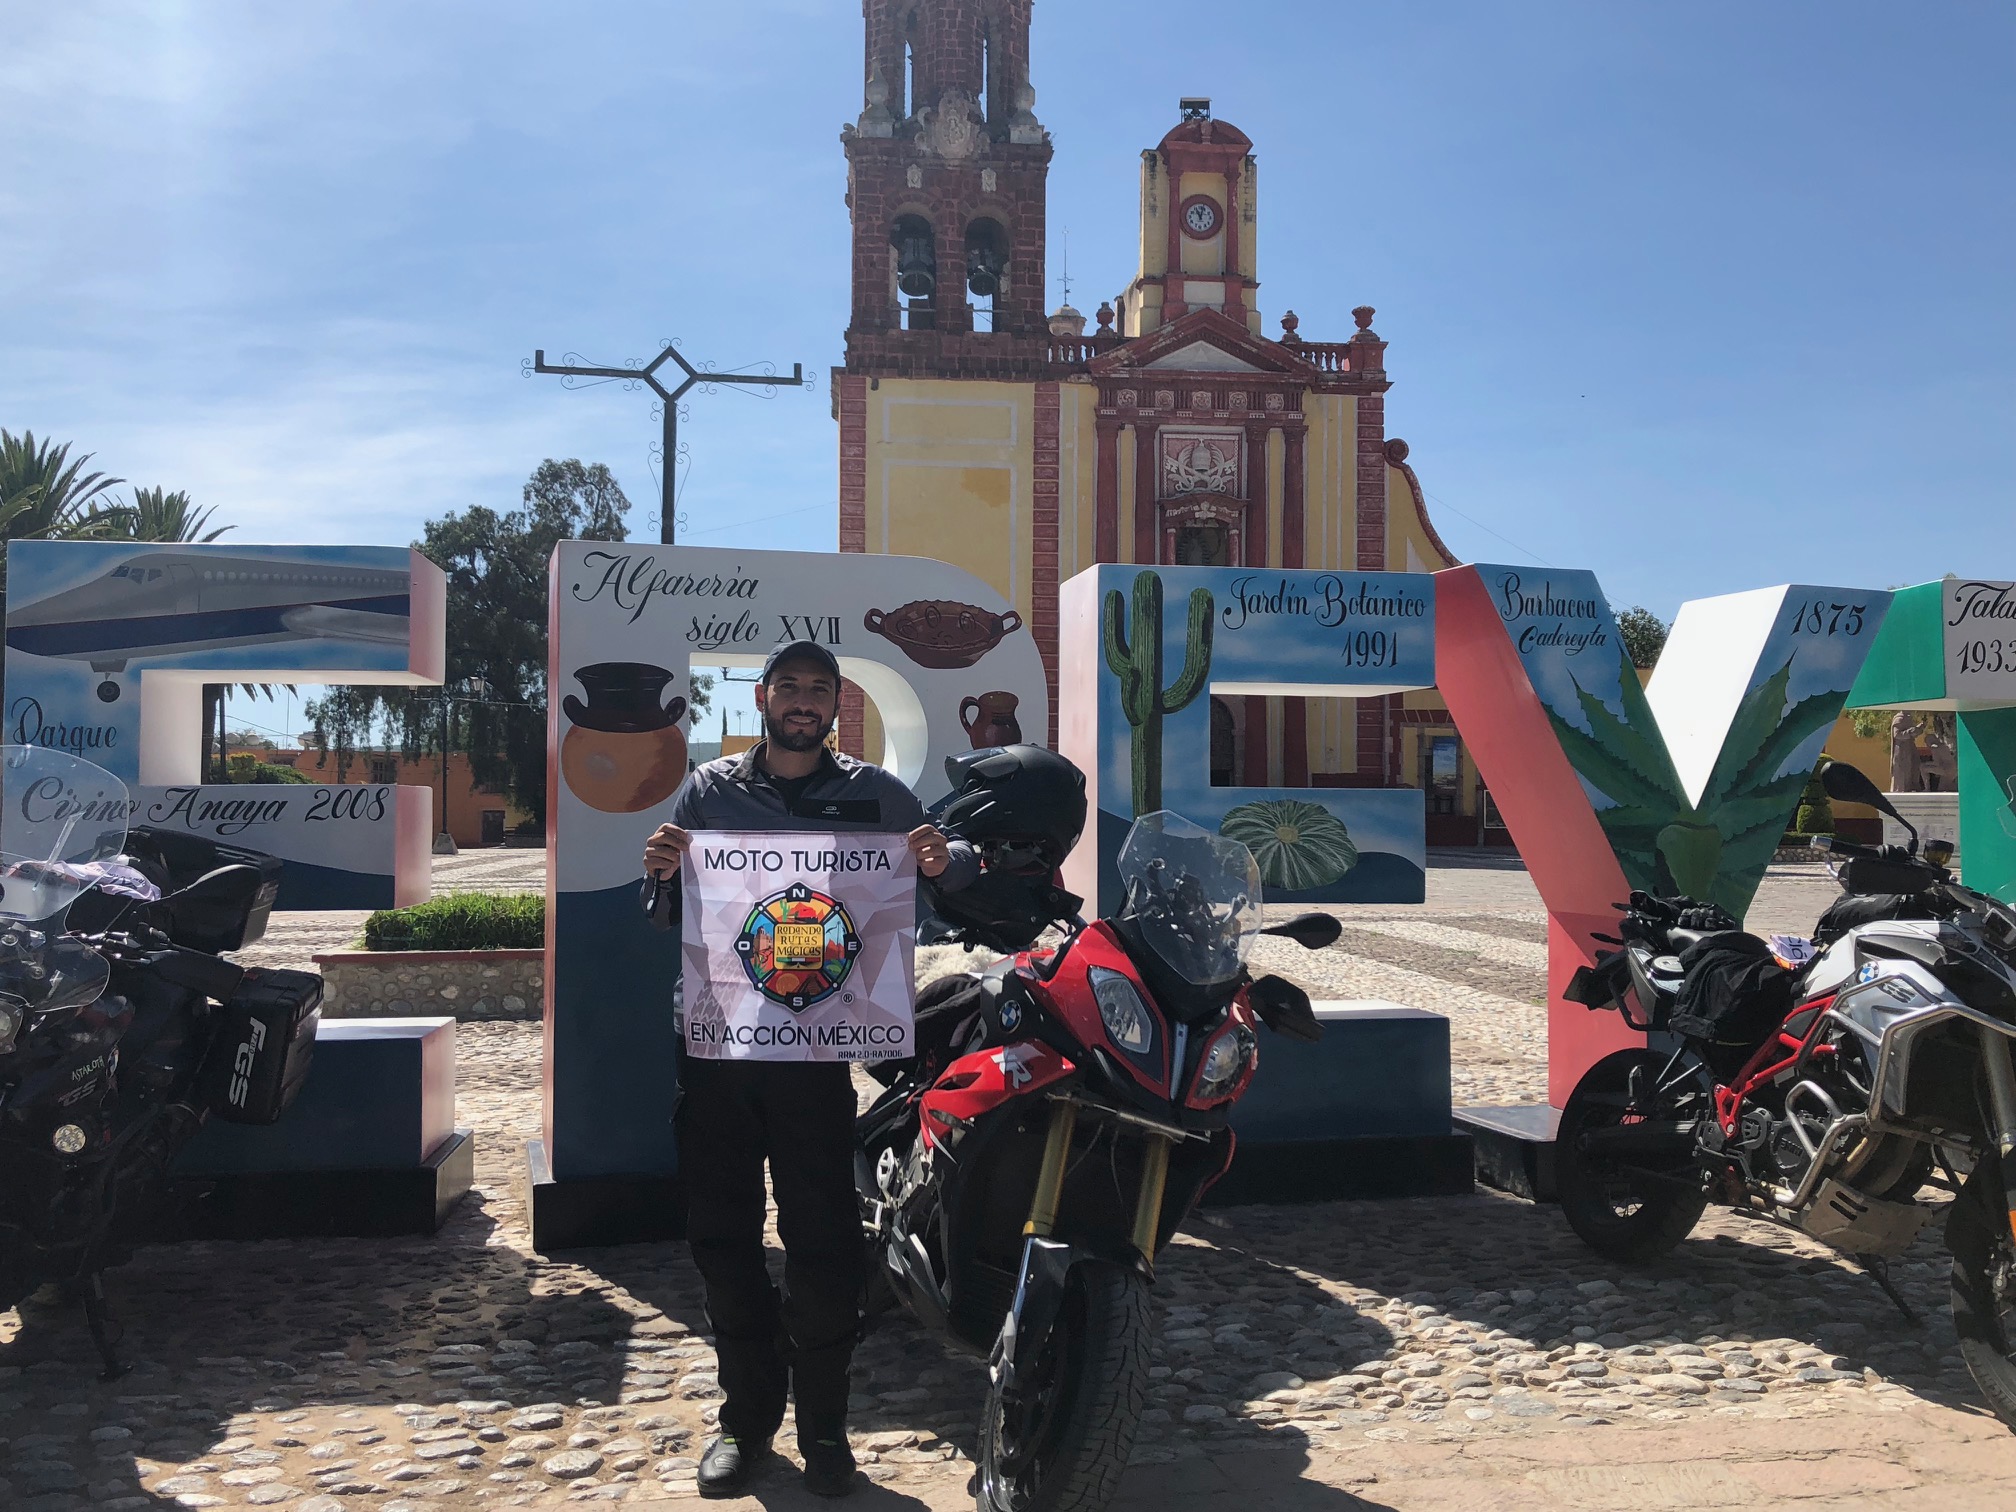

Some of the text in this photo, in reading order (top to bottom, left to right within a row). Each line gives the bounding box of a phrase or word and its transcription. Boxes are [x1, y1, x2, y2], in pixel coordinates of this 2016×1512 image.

[1222, 574, 1426, 631] Jardín Botánico
[1496, 571, 1599, 622] Barbacoa
[1948, 581, 2016, 627] Tala
[685, 609, 842, 651] siglo XVII
[1790, 600, 1867, 637] 1875
[1342, 630, 1399, 668] 1991
[1518, 622, 1607, 657] Cadereyta
[147, 787, 289, 835] Anaya
[304, 786, 391, 823] 2008
[704, 848, 891, 872] MOTO TURISTA
[792, 888, 805, 897] N
[848, 941, 857, 950] E
[792, 997, 803, 1006] S
[691, 1020, 905, 1046] EN ACCIÓN MÉXICO
[838, 1050, 856, 1059] RRM
